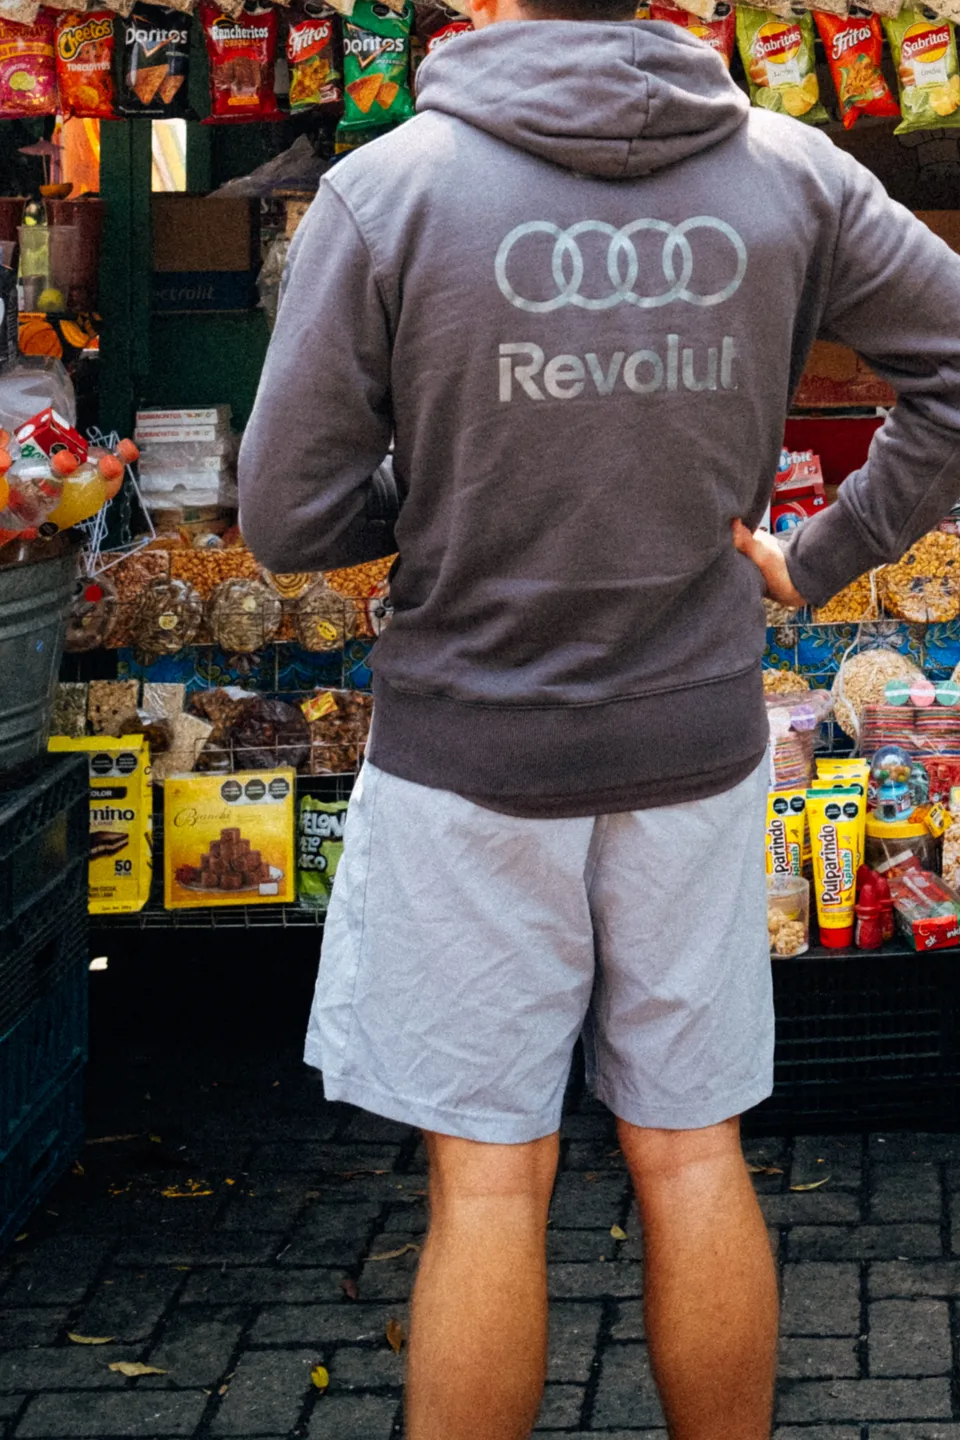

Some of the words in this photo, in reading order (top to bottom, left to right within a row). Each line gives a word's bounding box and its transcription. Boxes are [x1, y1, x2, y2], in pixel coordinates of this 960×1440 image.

[59, 18, 114, 61] Cheetos
[125, 27, 188, 45] Doritos
[211, 24, 269, 41] Rancheritos
[287, 22, 330, 60] Fritos
[342, 36, 405, 53] Doritos
[755, 29, 802, 58] Sabritas
[831, 24, 872, 60] Fritos
[902, 29, 950, 58] Sabritas
[498, 333, 739, 402] Revolut
[114, 860, 132, 872] 50
[820, 824, 842, 904] Pulparindo
